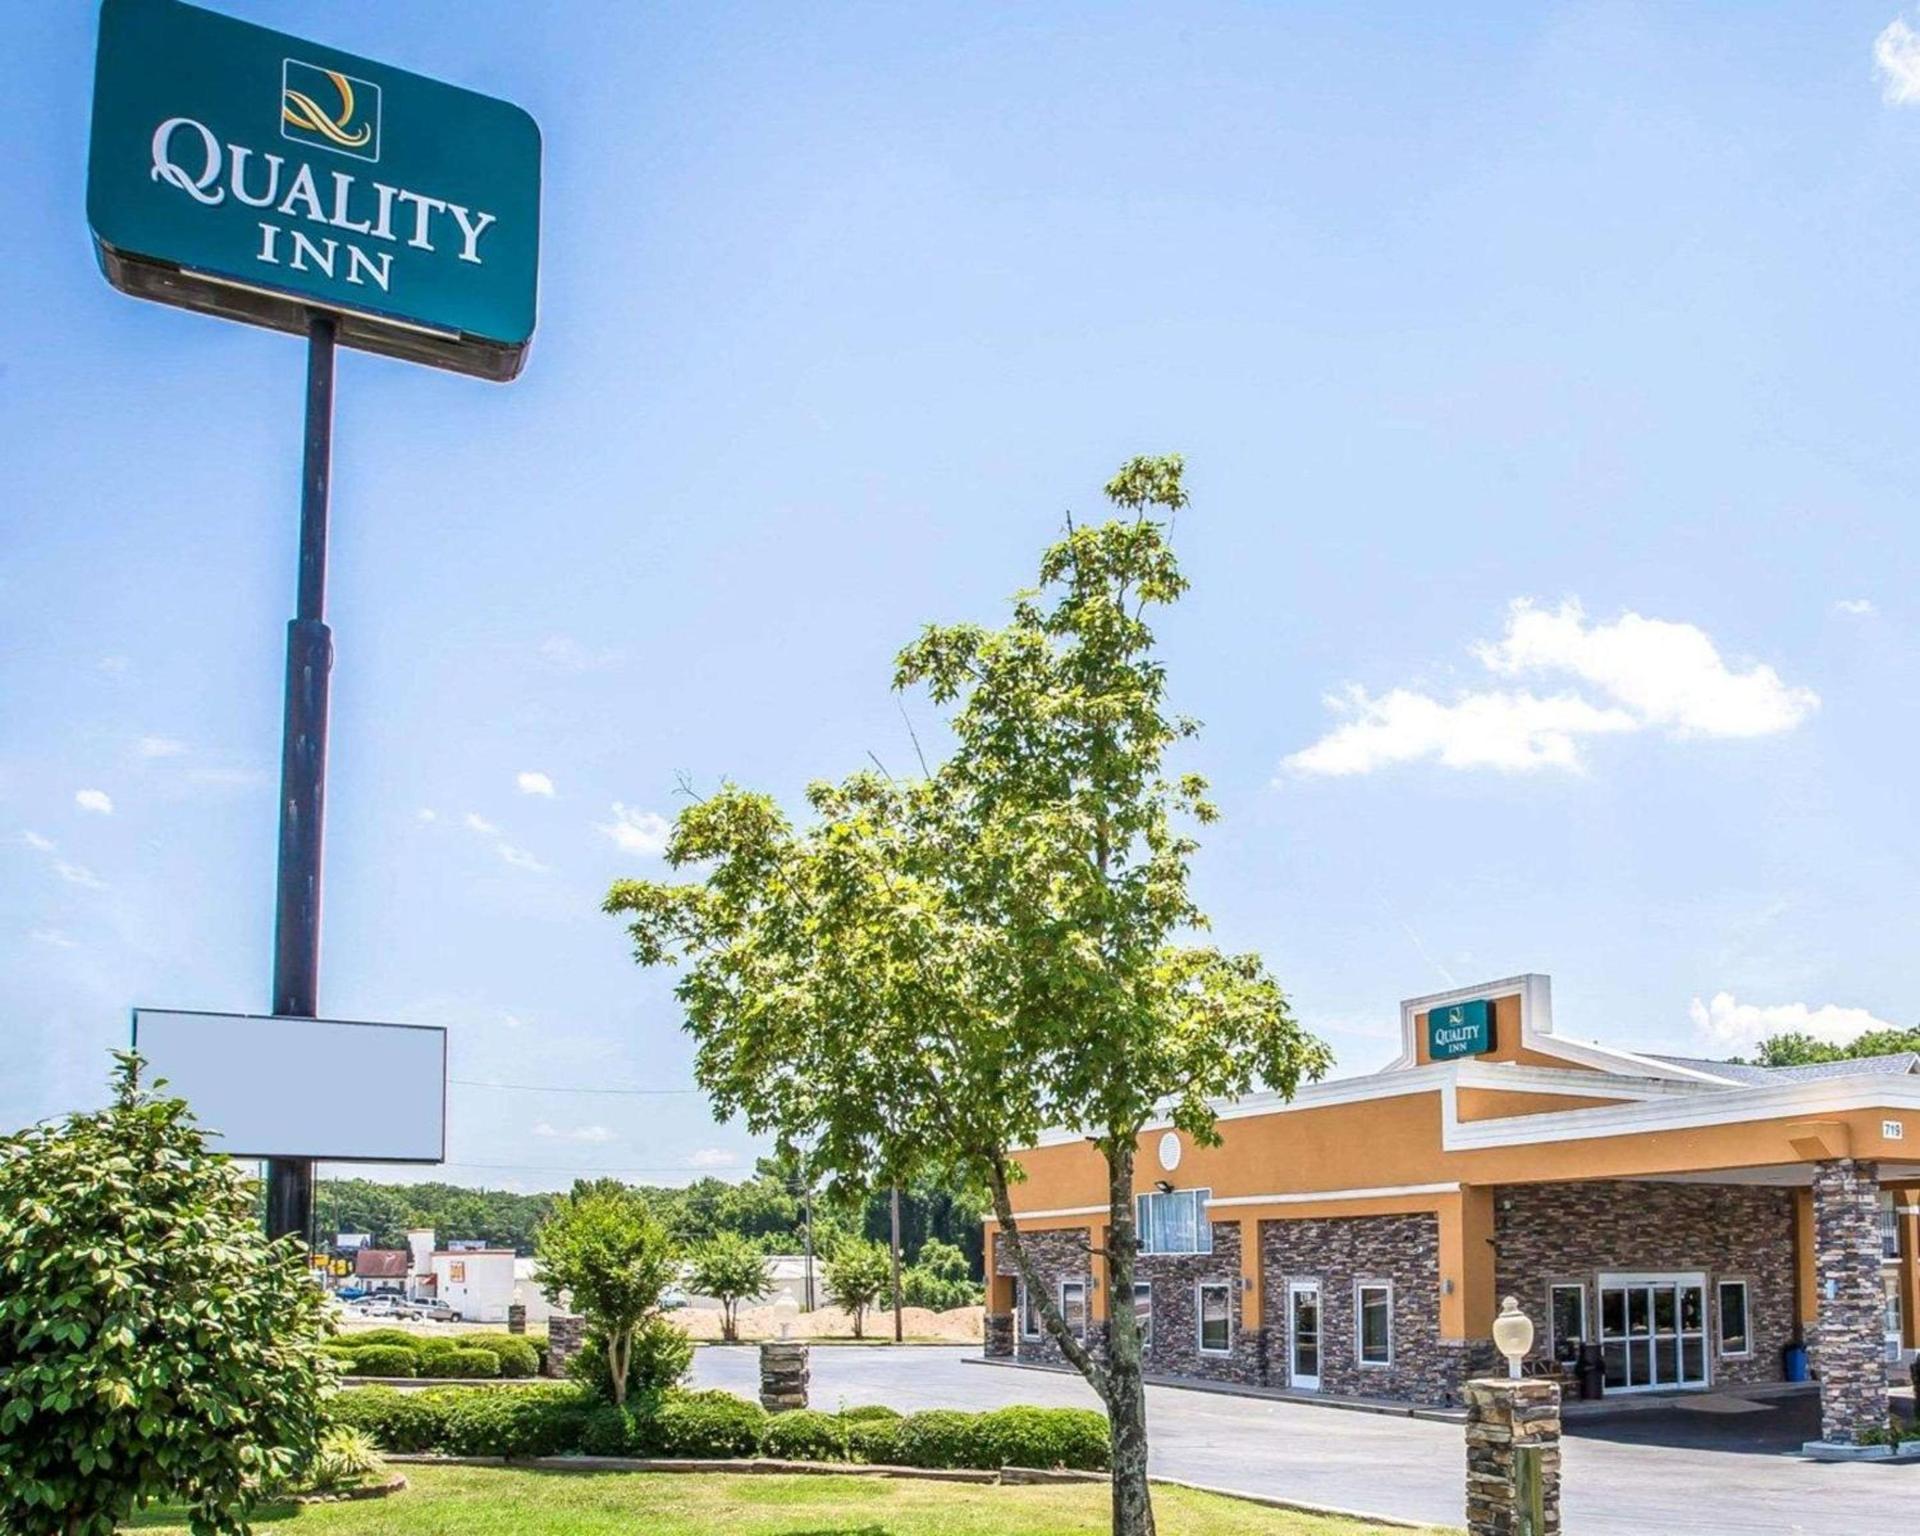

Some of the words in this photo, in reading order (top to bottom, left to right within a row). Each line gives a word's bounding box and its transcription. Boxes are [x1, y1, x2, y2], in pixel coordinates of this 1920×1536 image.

[151, 118, 496, 264] QUALITY
[257, 223, 394, 291] INN
[1435, 1025, 1479, 1046] QUALITY
[1448, 1042, 1468, 1054] INN
